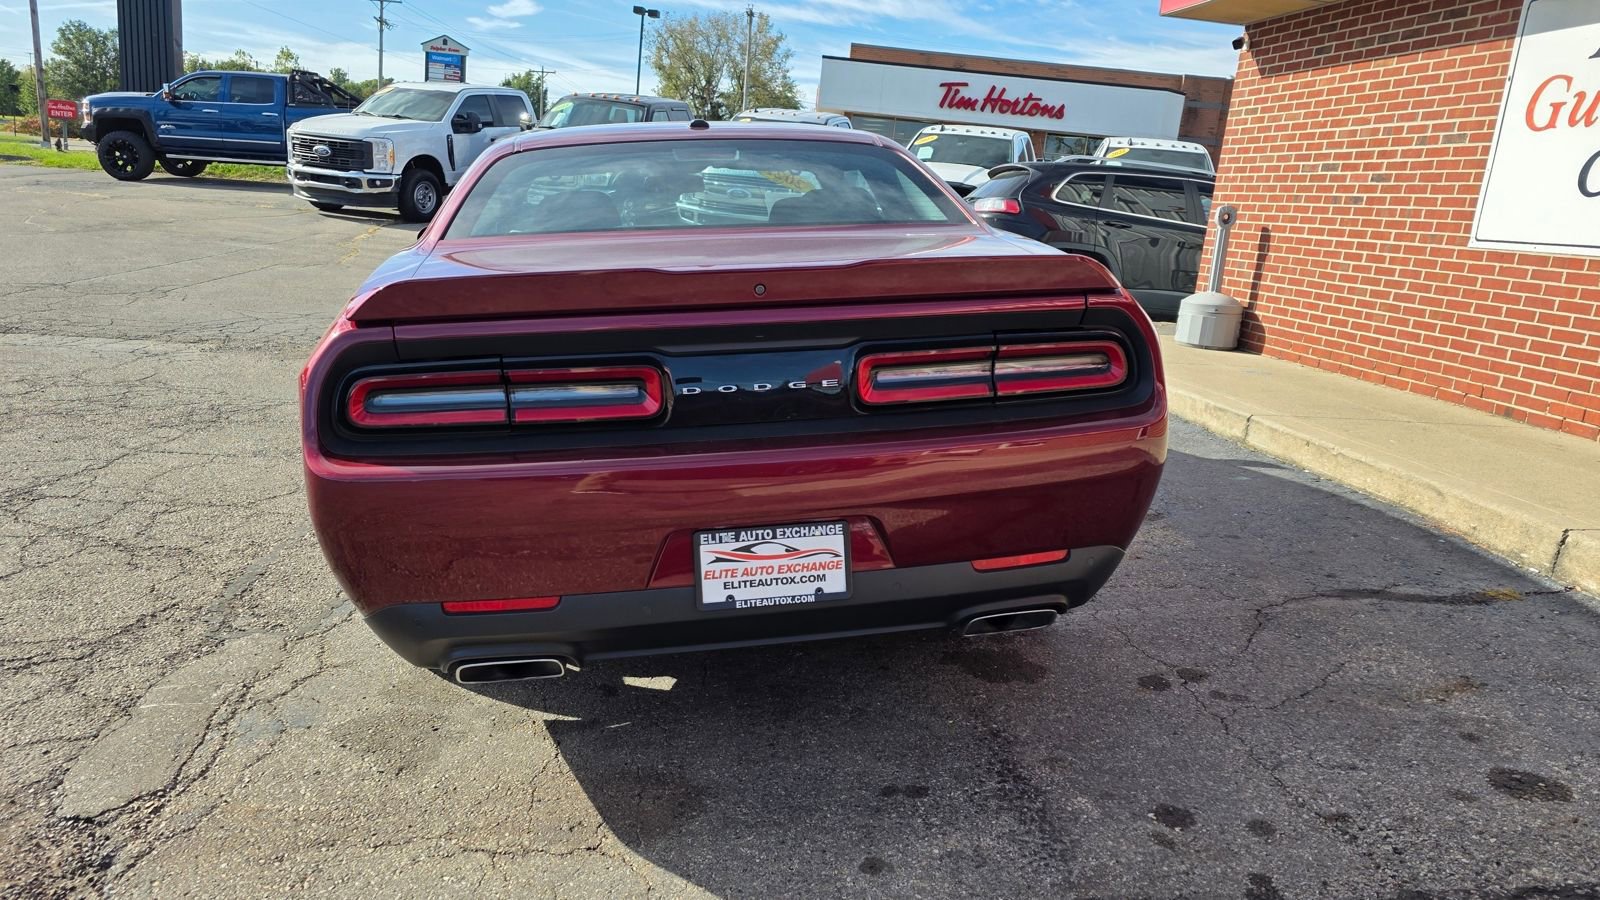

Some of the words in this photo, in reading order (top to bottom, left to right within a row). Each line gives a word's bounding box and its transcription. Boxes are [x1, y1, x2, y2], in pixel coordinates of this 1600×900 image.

[939, 82, 979, 111] Tim
[980, 85, 1065, 119] Hortons
[682, 379, 839, 395] DODGE
[700, 532, 736, 545] ELITE
[740, 530, 773, 542] AUTO
[776, 524, 844, 539] EXCHANGE
[704, 568, 738, 580] ELITE
[741, 565, 774, 577] AUTO
[777, 560, 843, 574] EXCHANGE
[723, 574, 827, 590] ELITEAUTOX.COM
[736, 595, 815, 609] ELITEAUTOX.COM
